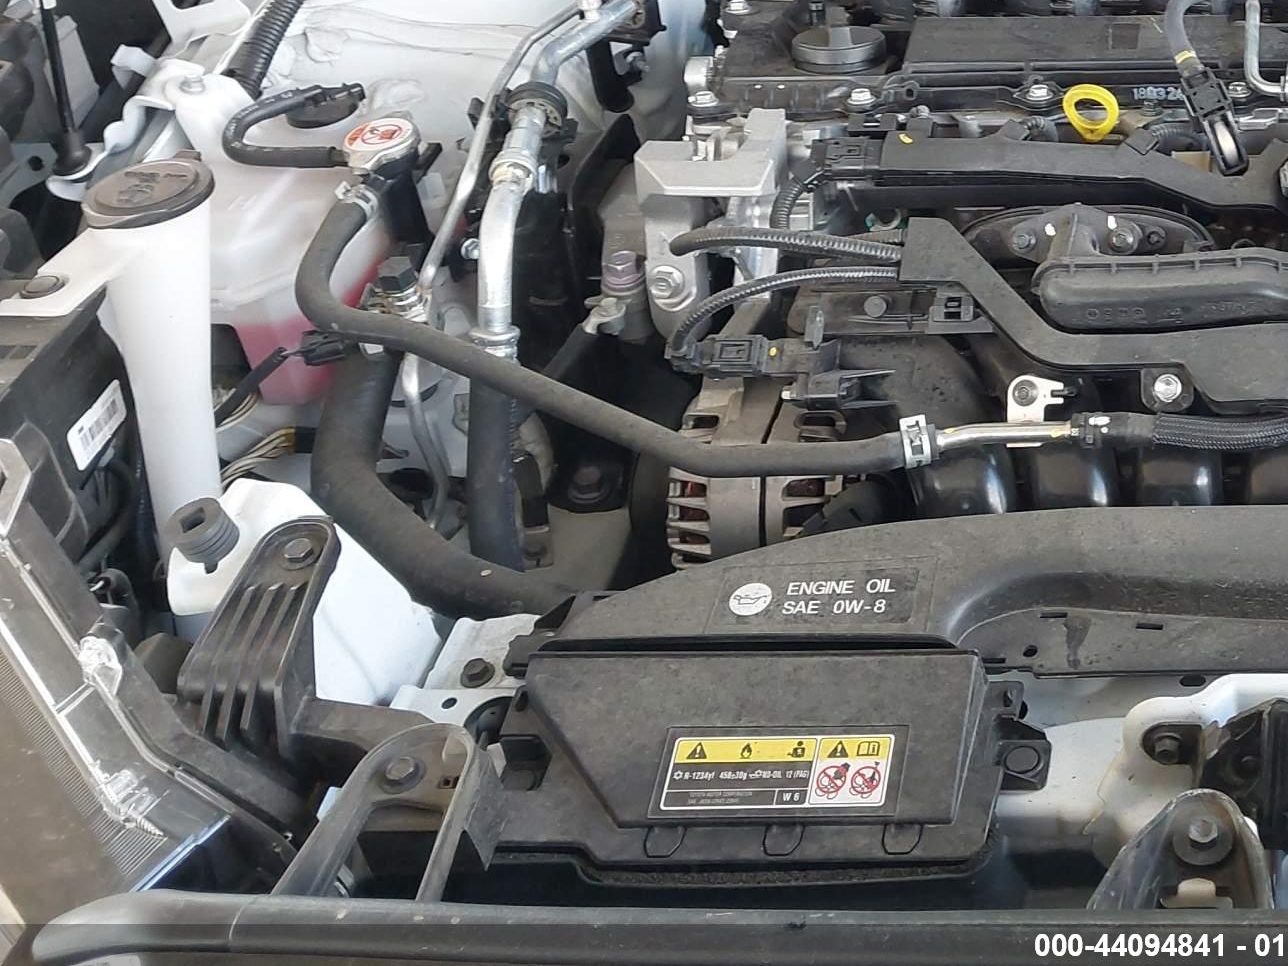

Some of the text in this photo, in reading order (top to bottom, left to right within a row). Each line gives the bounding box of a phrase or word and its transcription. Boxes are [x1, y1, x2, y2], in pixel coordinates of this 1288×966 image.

[787, 578, 896, 596] ENGINE OIL
[782, 599, 887, 615] SAE 0W-8
[783, 792, 793, 802] W
